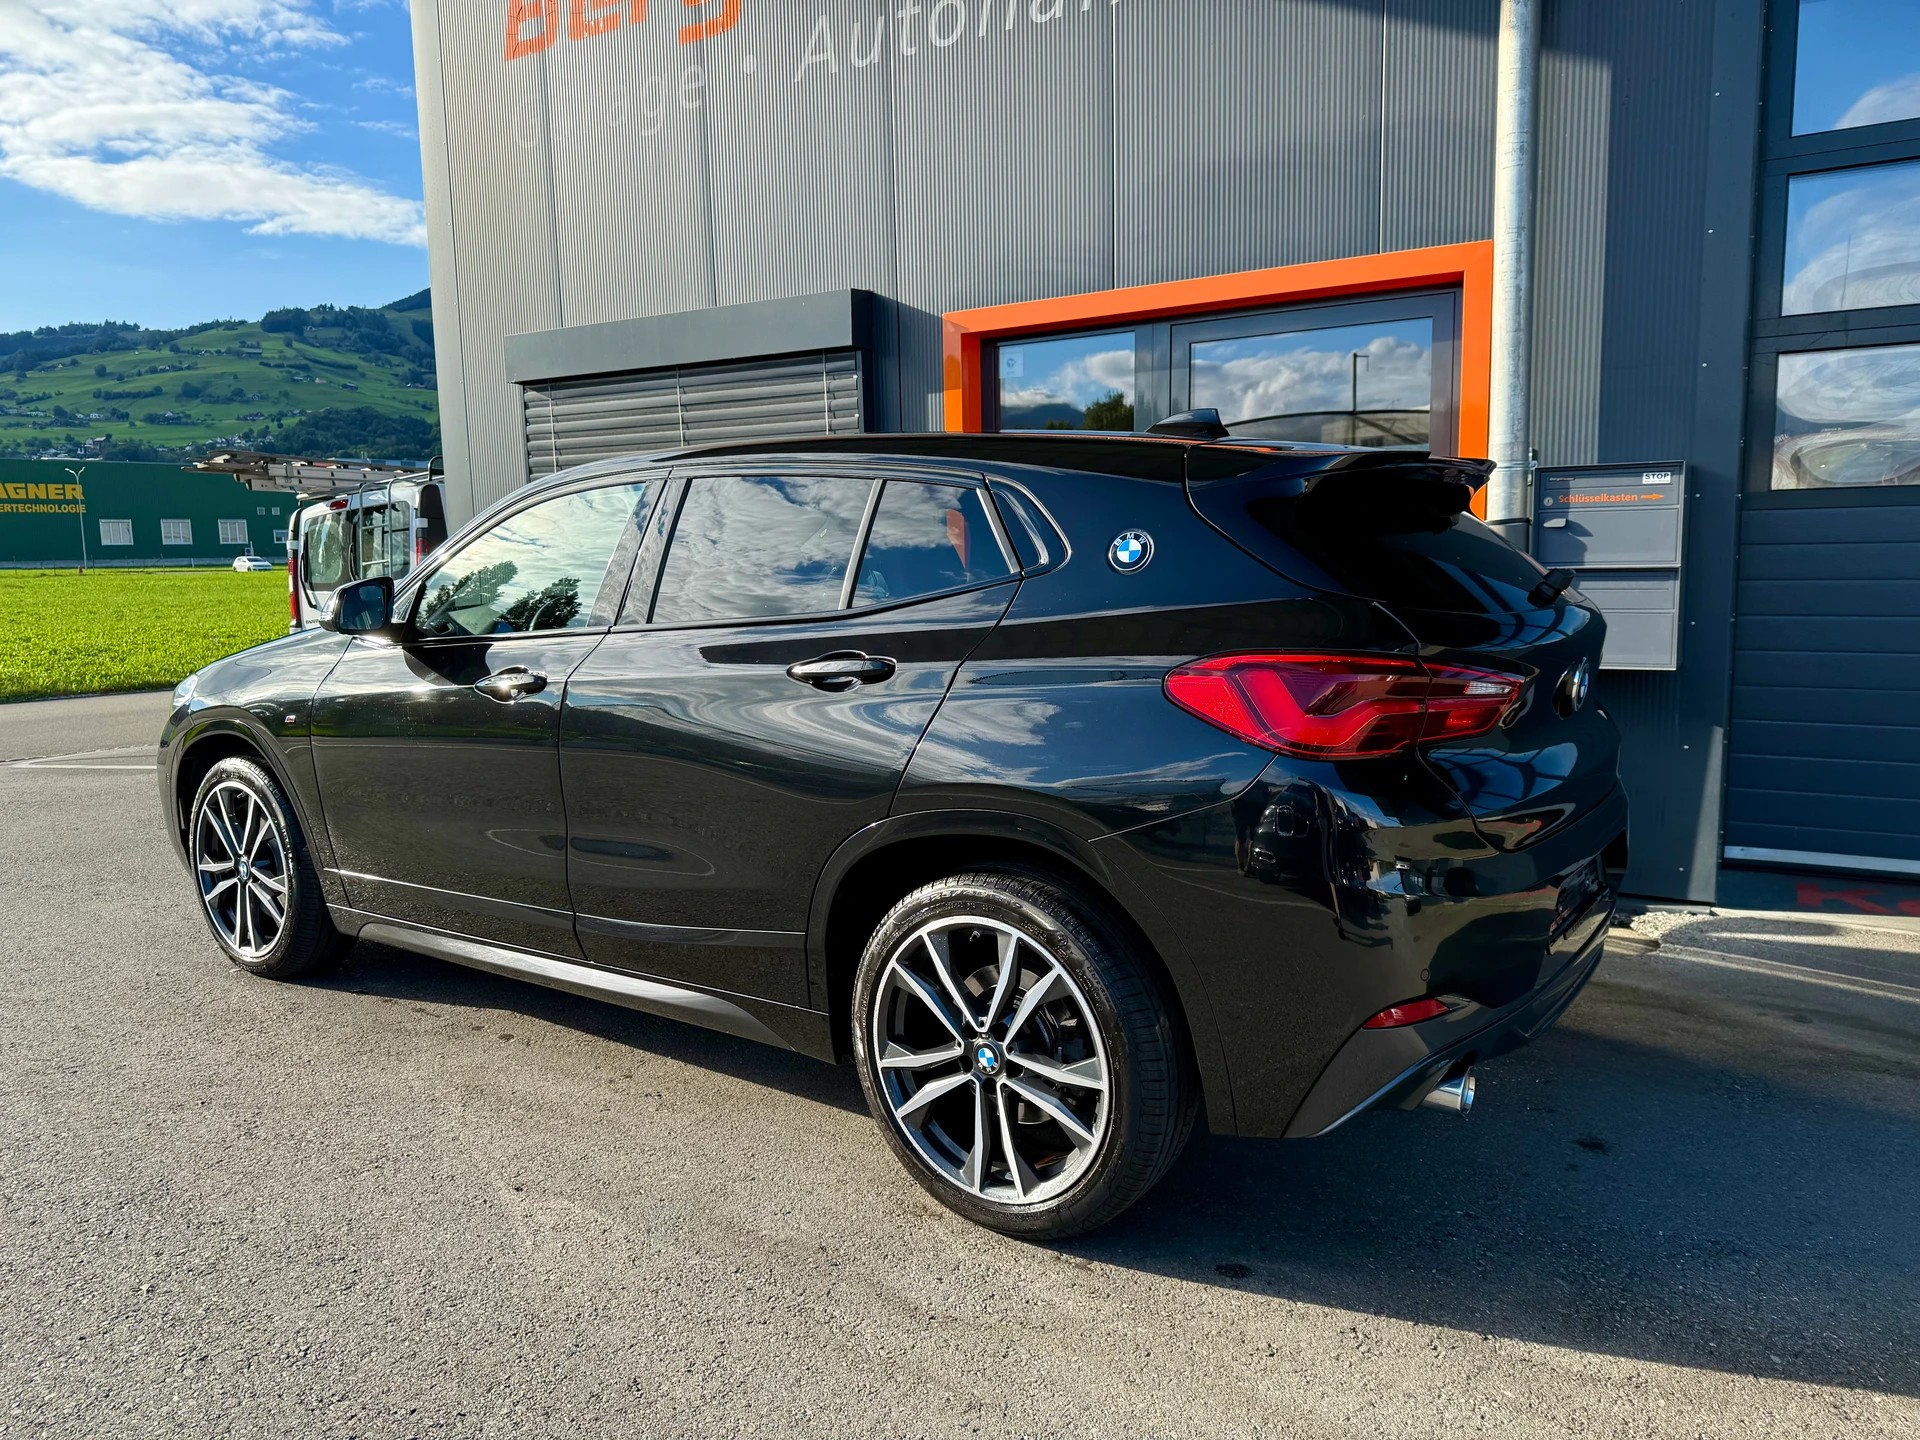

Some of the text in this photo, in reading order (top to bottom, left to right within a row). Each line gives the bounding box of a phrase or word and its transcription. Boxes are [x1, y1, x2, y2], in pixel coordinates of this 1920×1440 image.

[504, 0, 741, 61] Beg
[511, 64, 706, 149] Gage
[1558, 493, 1638, 503] Schlüsselkasten
[1115, 533, 1147, 546] BMW
